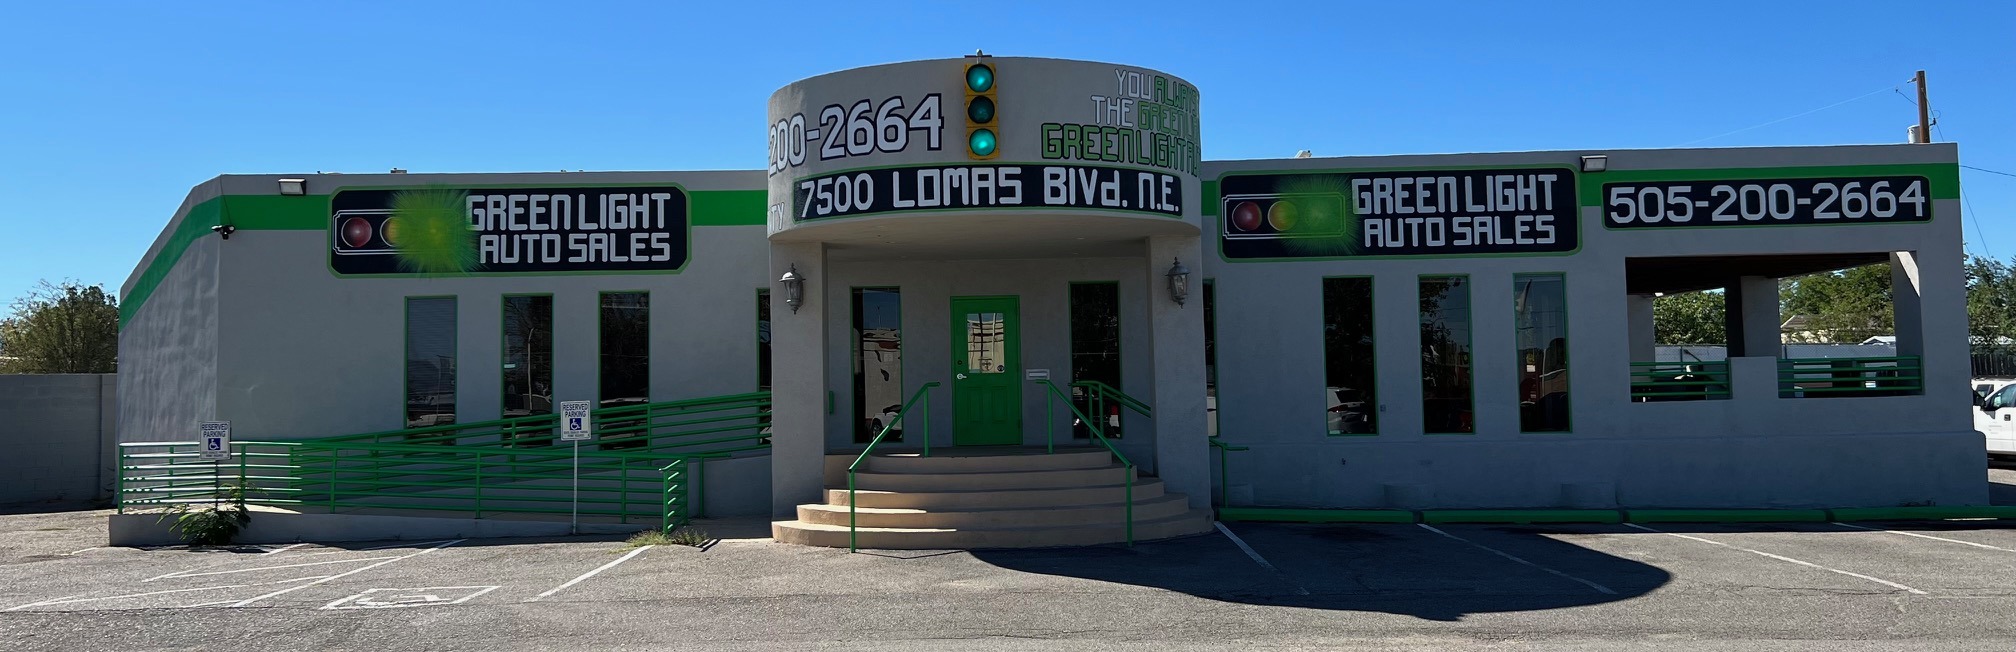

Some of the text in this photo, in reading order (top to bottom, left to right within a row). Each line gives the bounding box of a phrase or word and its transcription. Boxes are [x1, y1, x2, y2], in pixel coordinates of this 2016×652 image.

[1115, 69, 1151, 100] YOU
[1091, 95, 1134, 128] THE
[801, 172, 874, 218] 7500
[892, 167, 1022, 207] LOMAS
[1138, 172, 1179, 212] N.E.
[1610, 180, 1926, 224] 505-200-2664
[1364, 215, 1556, 248] AUTO SALES
[479, 232, 671, 264] AUTO SALES
[562, 403, 588, 411] RESERVED
[564, 410, 587, 418] PARKING
[201, 423, 228, 431] RESERVED
[203, 430, 226, 438] PARKING
